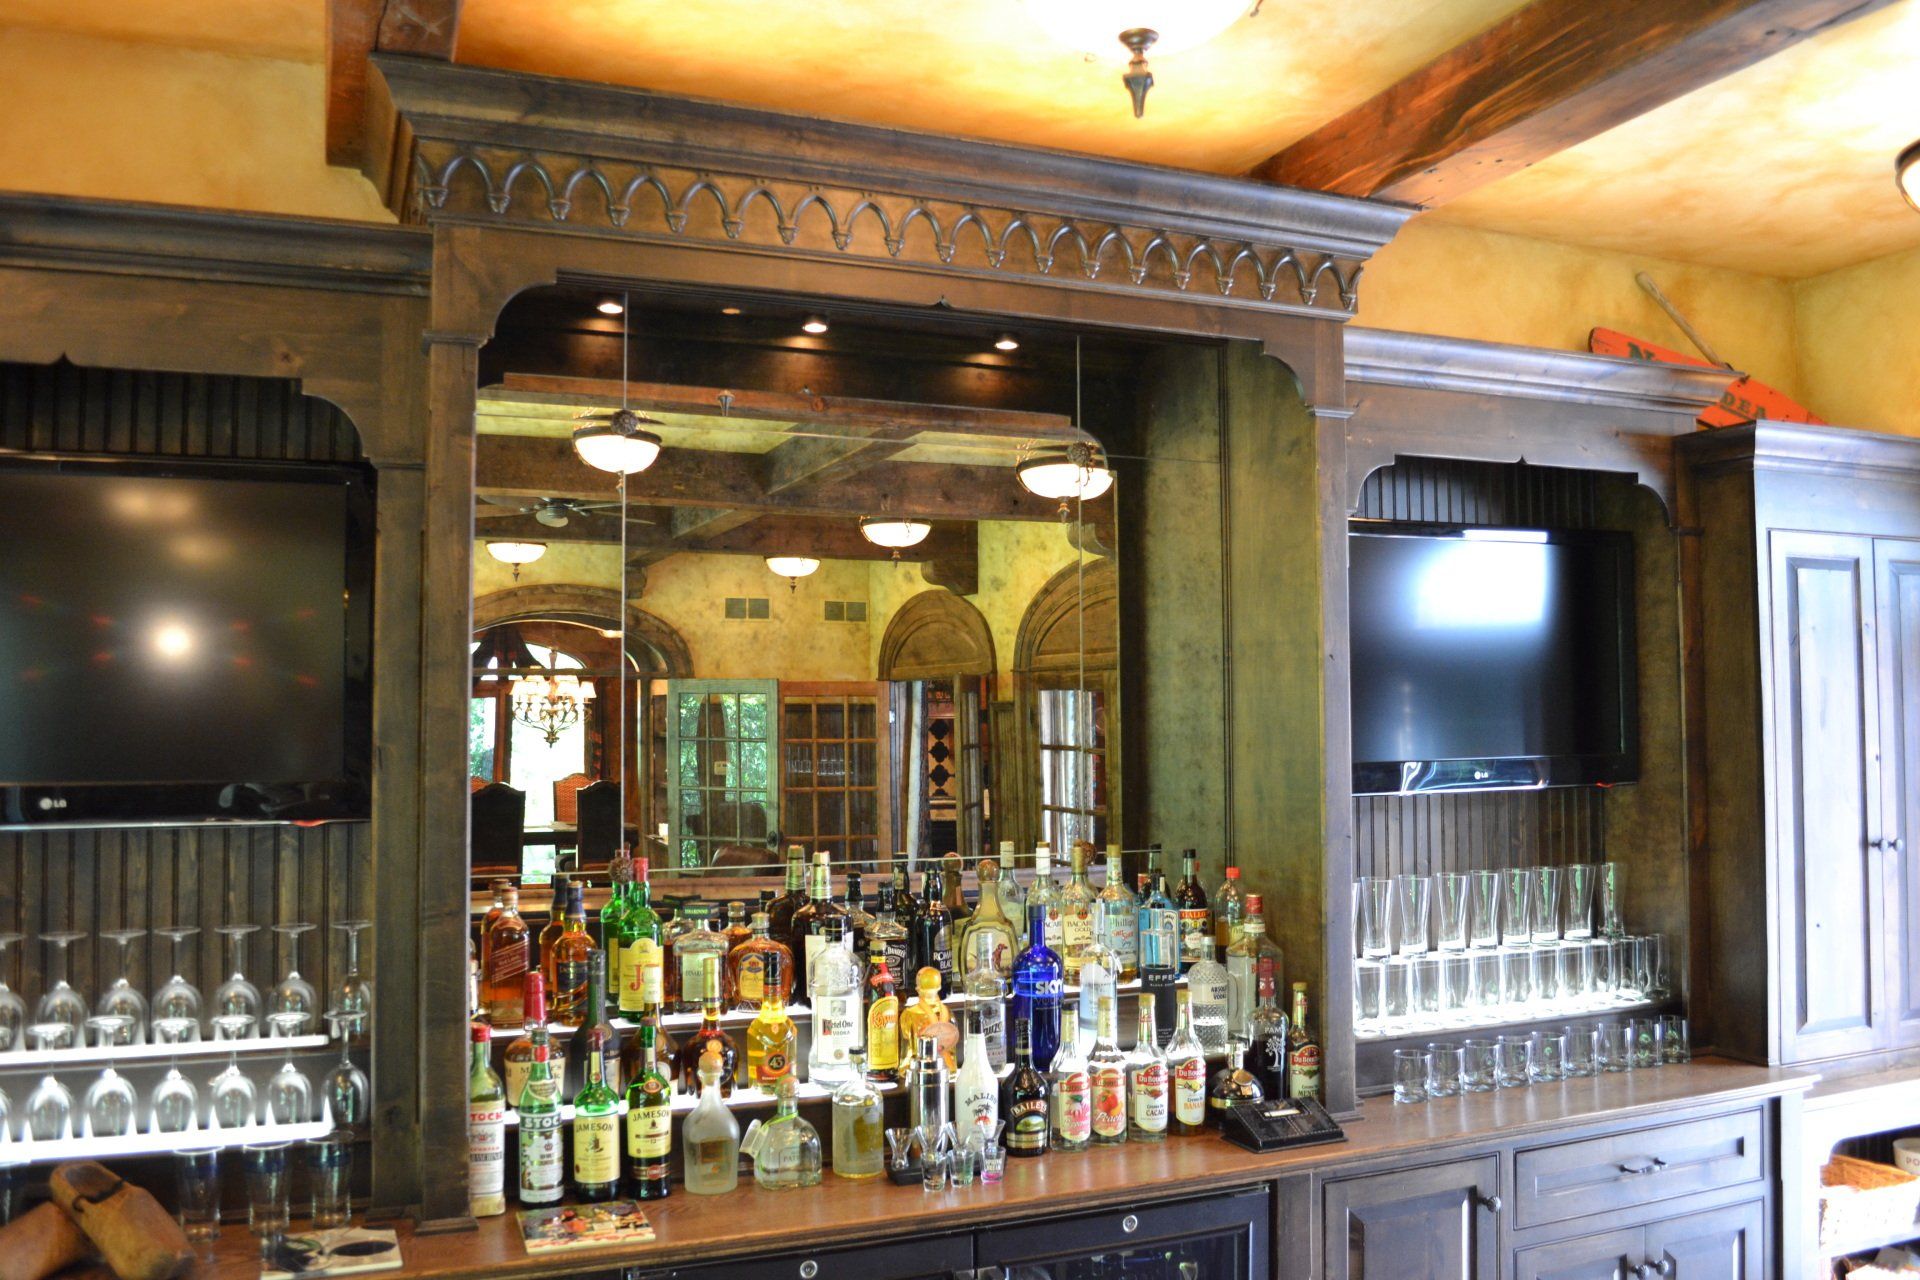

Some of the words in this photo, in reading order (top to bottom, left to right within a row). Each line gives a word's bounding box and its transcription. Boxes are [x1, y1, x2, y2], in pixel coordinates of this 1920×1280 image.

[1013, 1101, 1048, 1115] BAILEYS
[470, 1112, 503, 1121] TOCK
[633, 1109, 669, 1122] JAMESON
[525, 1116, 561, 1129] STOC
[576, 1121, 614, 1133] JAMESON
